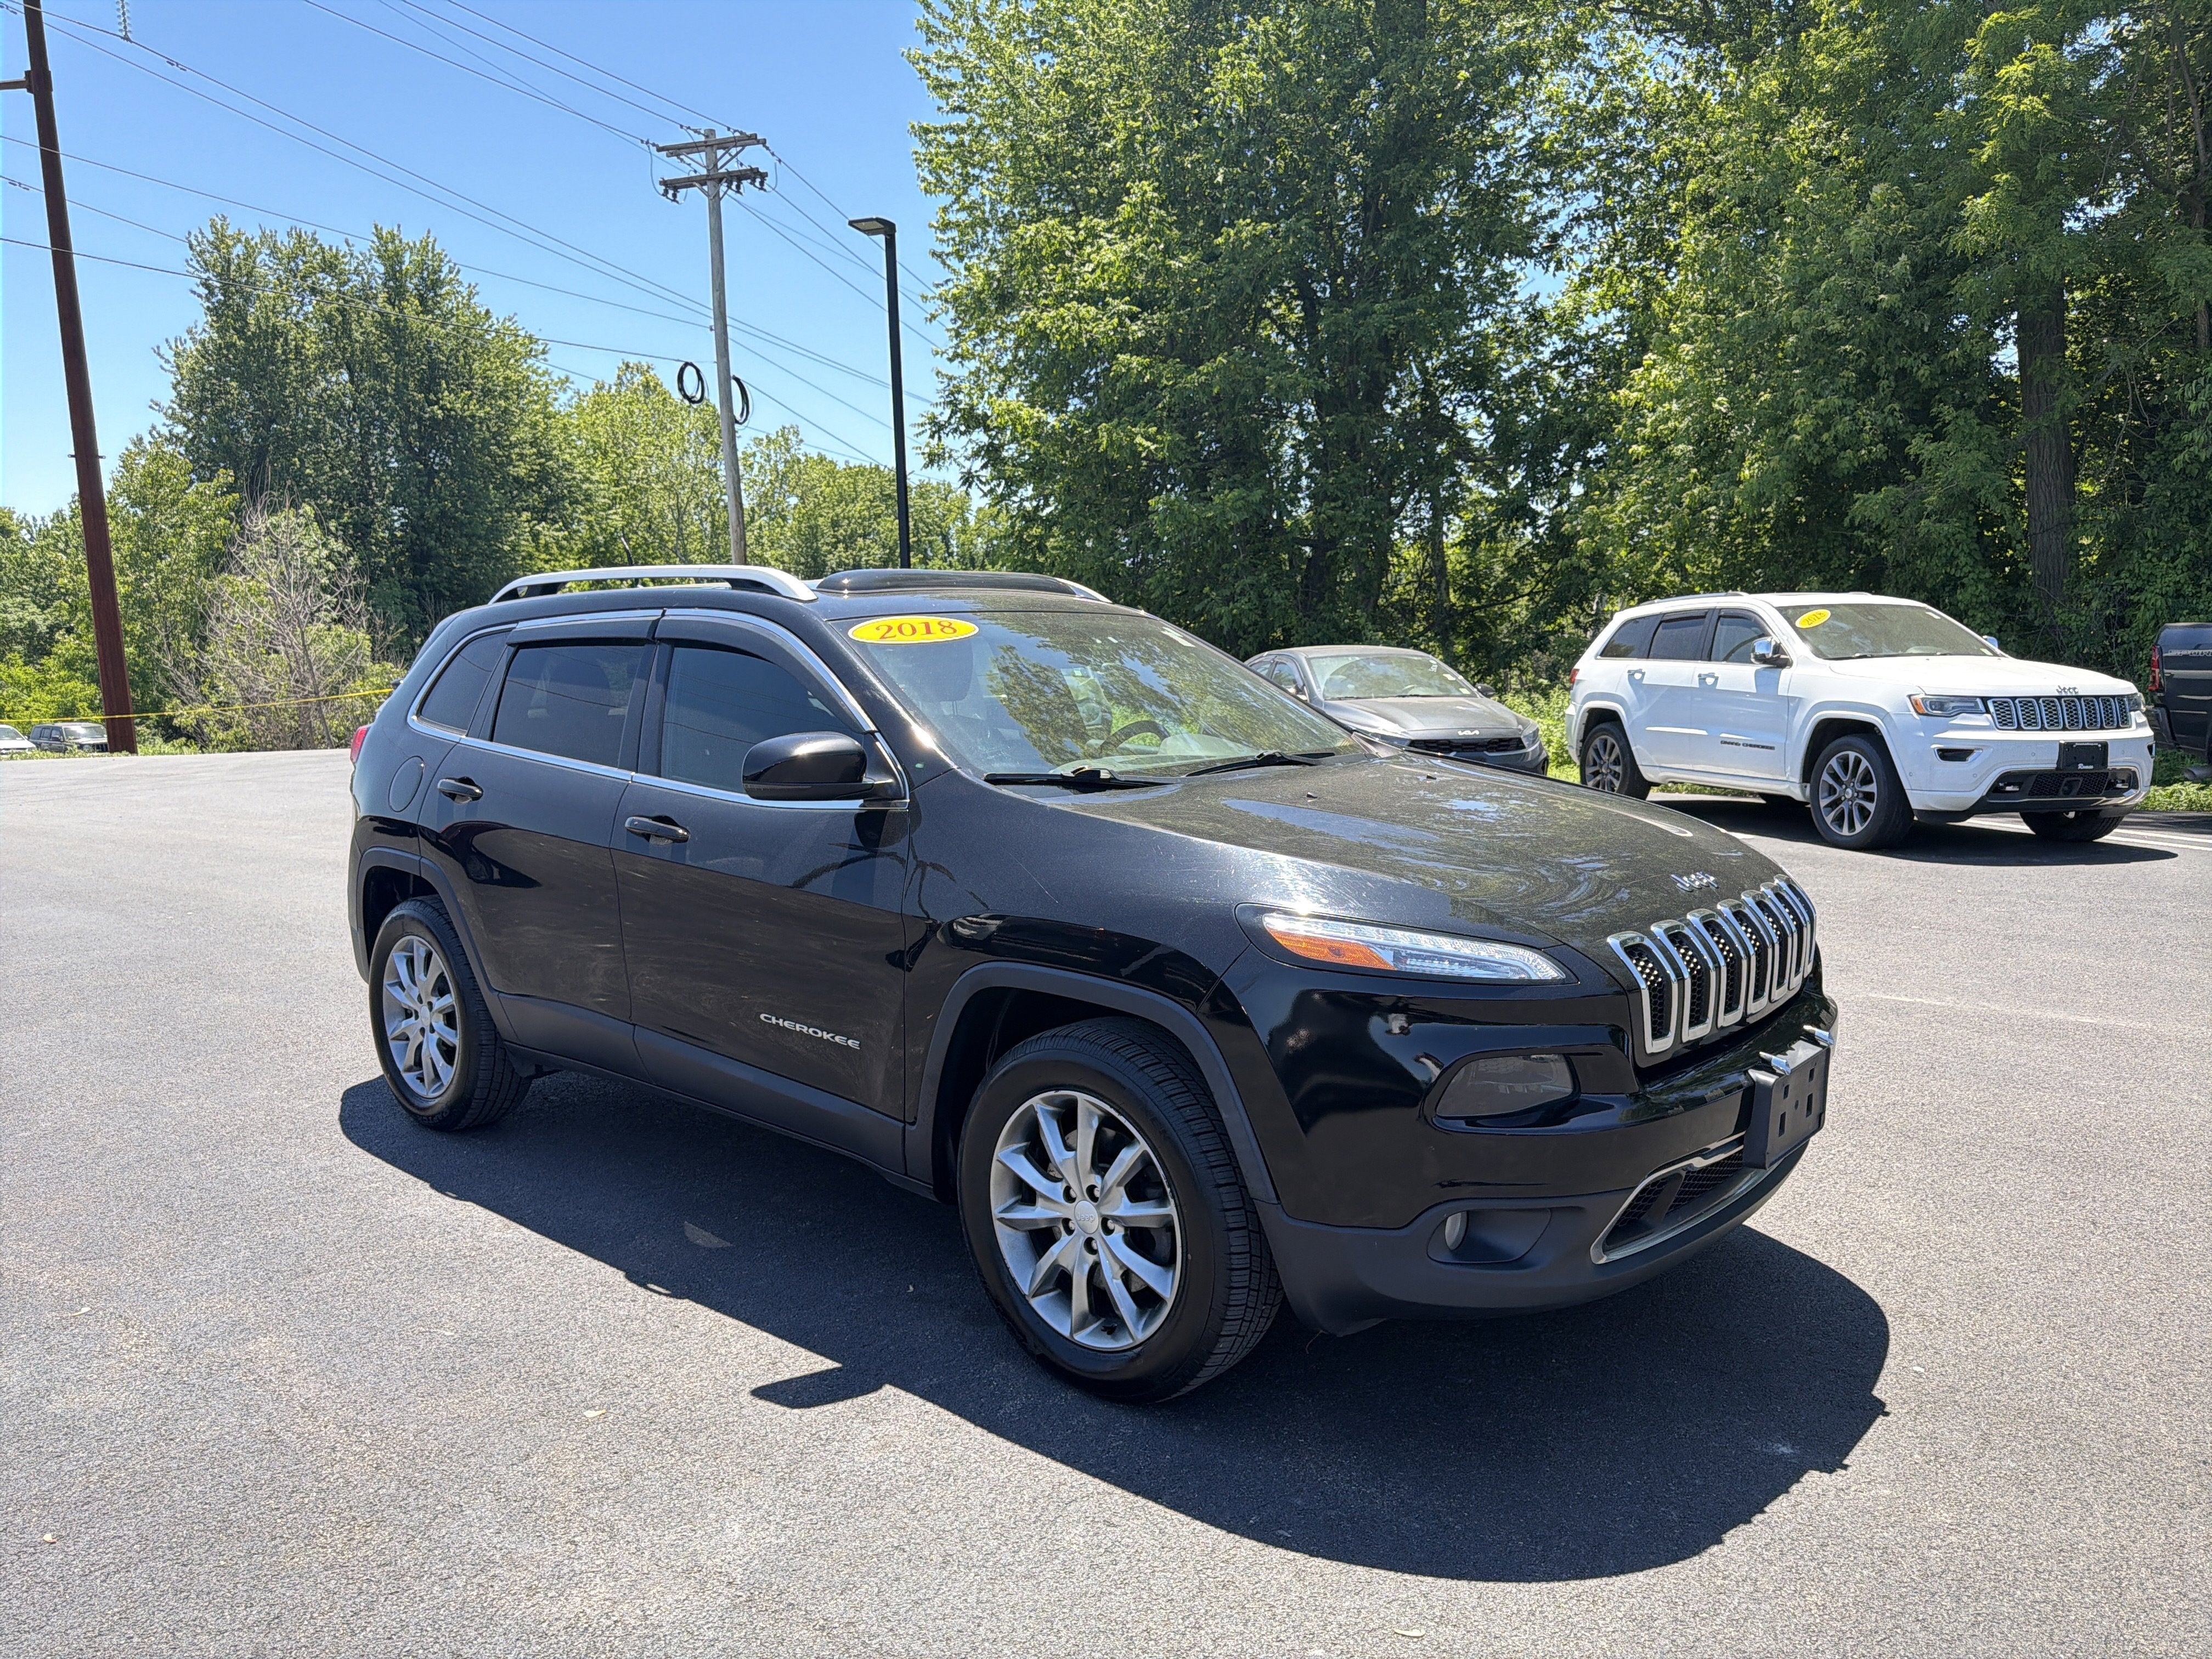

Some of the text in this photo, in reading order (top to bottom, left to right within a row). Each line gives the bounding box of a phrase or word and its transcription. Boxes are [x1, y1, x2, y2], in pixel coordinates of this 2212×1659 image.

[875, 620, 957, 640] 2018
[1671, 872, 1718, 893] Jeep
[760, 1013, 861, 1050] CHEROKEE
[1076, 1212, 1095, 1223] Jeep
